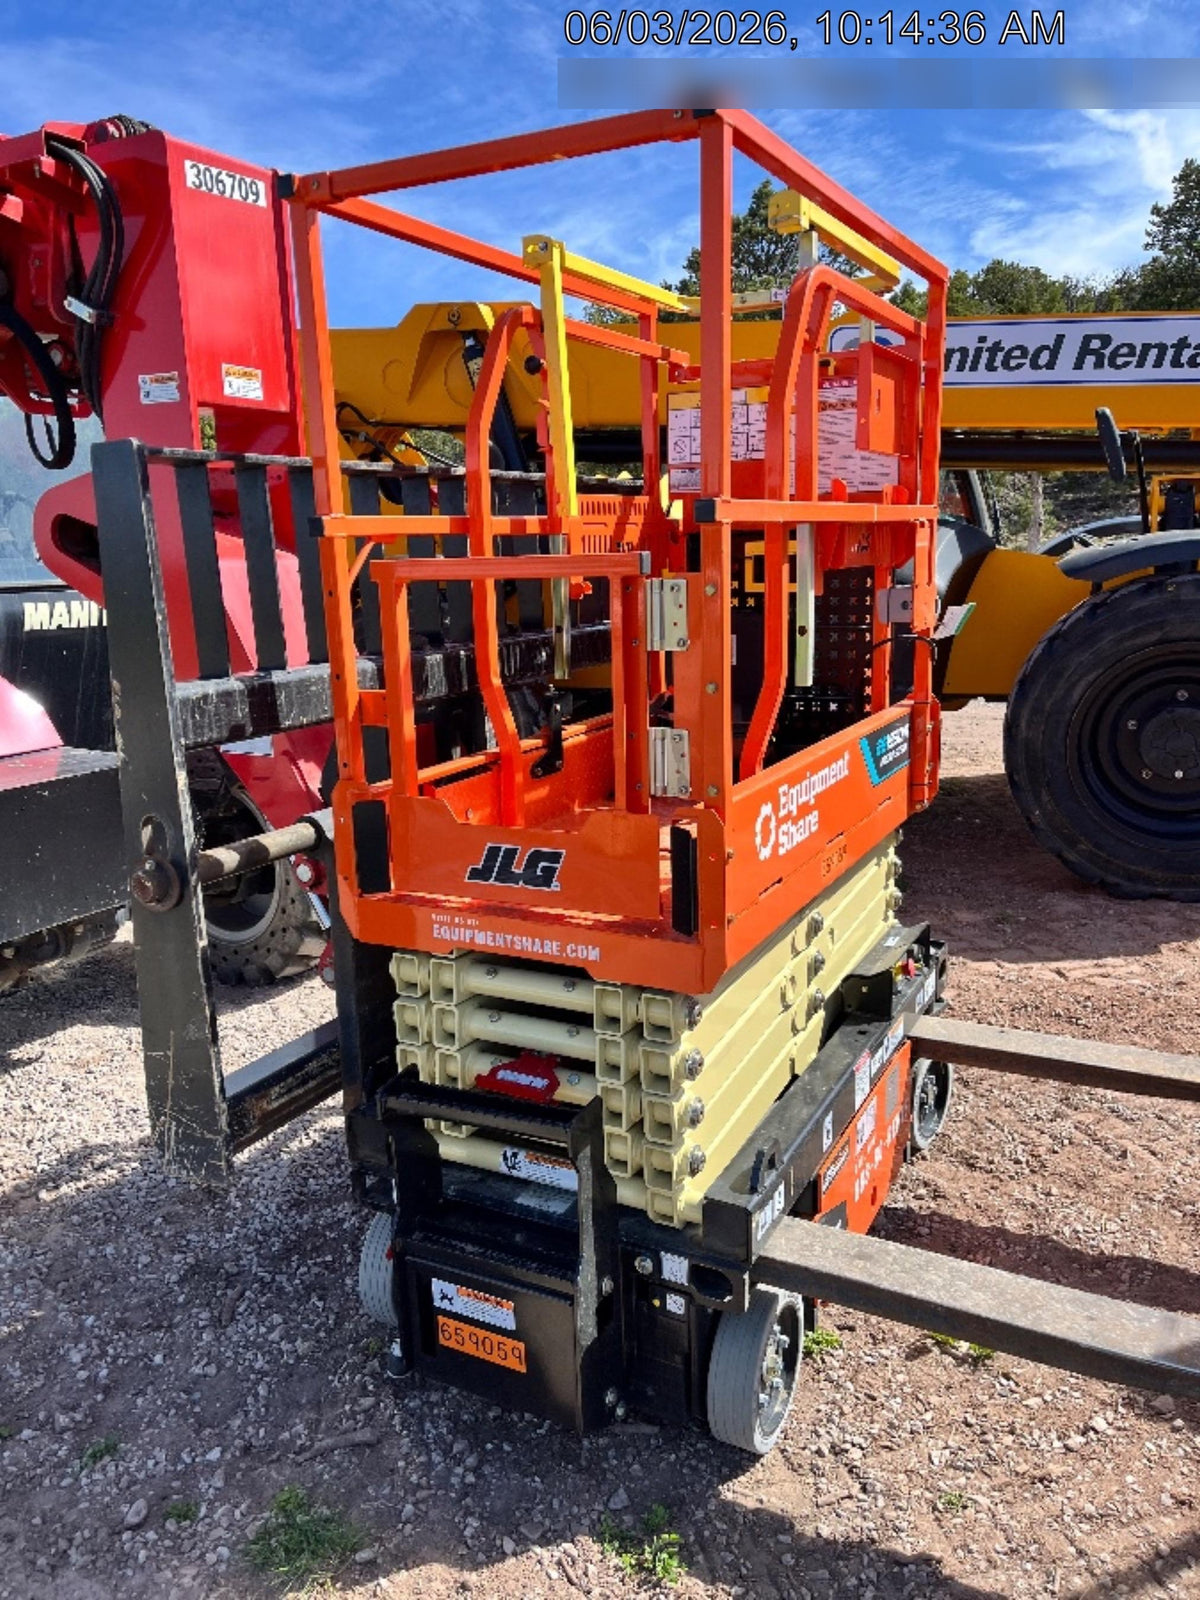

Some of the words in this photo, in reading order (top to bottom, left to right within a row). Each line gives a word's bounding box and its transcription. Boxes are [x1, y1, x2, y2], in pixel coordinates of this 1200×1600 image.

[189, 163, 260, 203] 306709
[944, 334, 1066, 372] nited
[778, 750, 850, 818] Equipment
[778, 810, 819, 856] Share
[464, 842, 566, 891] JLG
[433, 924, 600, 962] EQUIPMENTSHARE.COM
[440, 1322, 523, 1366] 659059
